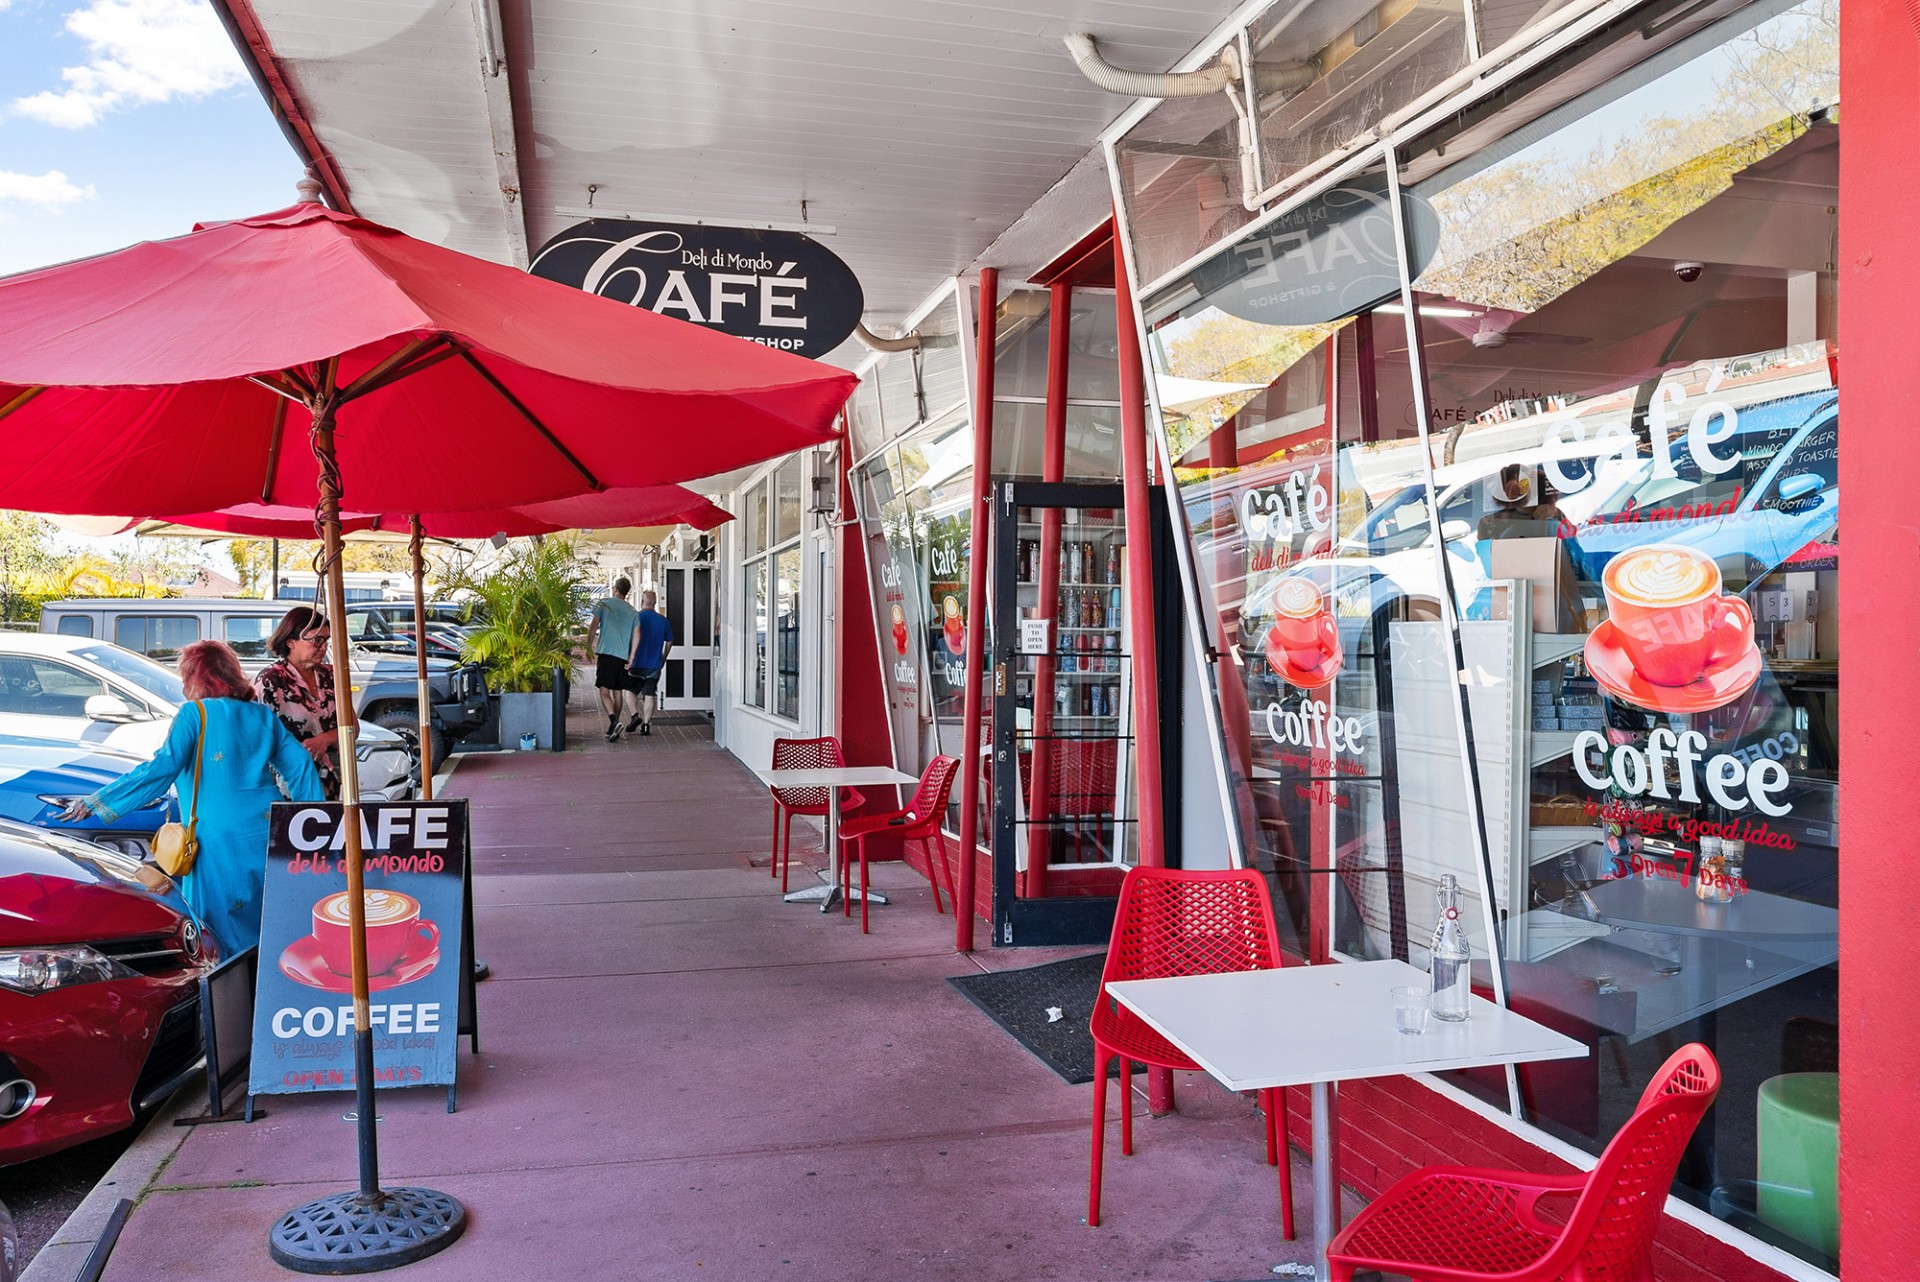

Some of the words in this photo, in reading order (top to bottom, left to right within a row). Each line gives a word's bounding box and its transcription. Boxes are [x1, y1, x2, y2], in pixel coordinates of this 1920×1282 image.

[681, 249, 708, 270] Deli
[711, 249, 725, 268] di
[727, 252, 773, 271] Mondo
[528, 230, 808, 330] CAFÉ
[1543, 364, 1743, 494] Café
[1241, 463, 1332, 542] Café
[881, 556, 902, 588] Café
[932, 540, 959, 577] Café
[1251, 548, 1275, 573] deli
[1276, 545, 1292, 569] di
[1799, 556, 1836, 569] ORDER
[1769, 597, 1776, 607] 5
[1783, 597, 1789, 607] 3
[894, 660, 916, 684] Coffee
[945, 660, 967, 686] Coff
[1265, 699, 1364, 755] Coffee
[1316, 757, 1342, 775] good
[1343, 757, 1366, 776] idea
[1572, 727, 1794, 817] Coffee
[1314, 779, 1324, 806] 7
[288, 807, 449, 851] CAFE
[1584, 796, 1598, 817] is
[1601, 799, 1665, 835] always
[1667, 814, 1684, 831] a
[1682, 817, 1743, 843] good
[1742, 820, 1797, 851] idea
[287, 852, 331, 875] deli
[365, 850, 445, 877] mondo
[1631, 853, 1677, 880] Open
[1674, 849, 1694, 889] 7
[1699, 866, 1750, 897] Days
[271, 1002, 440, 1039] COFFEE
[283, 1068, 344, 1088] OPEN
